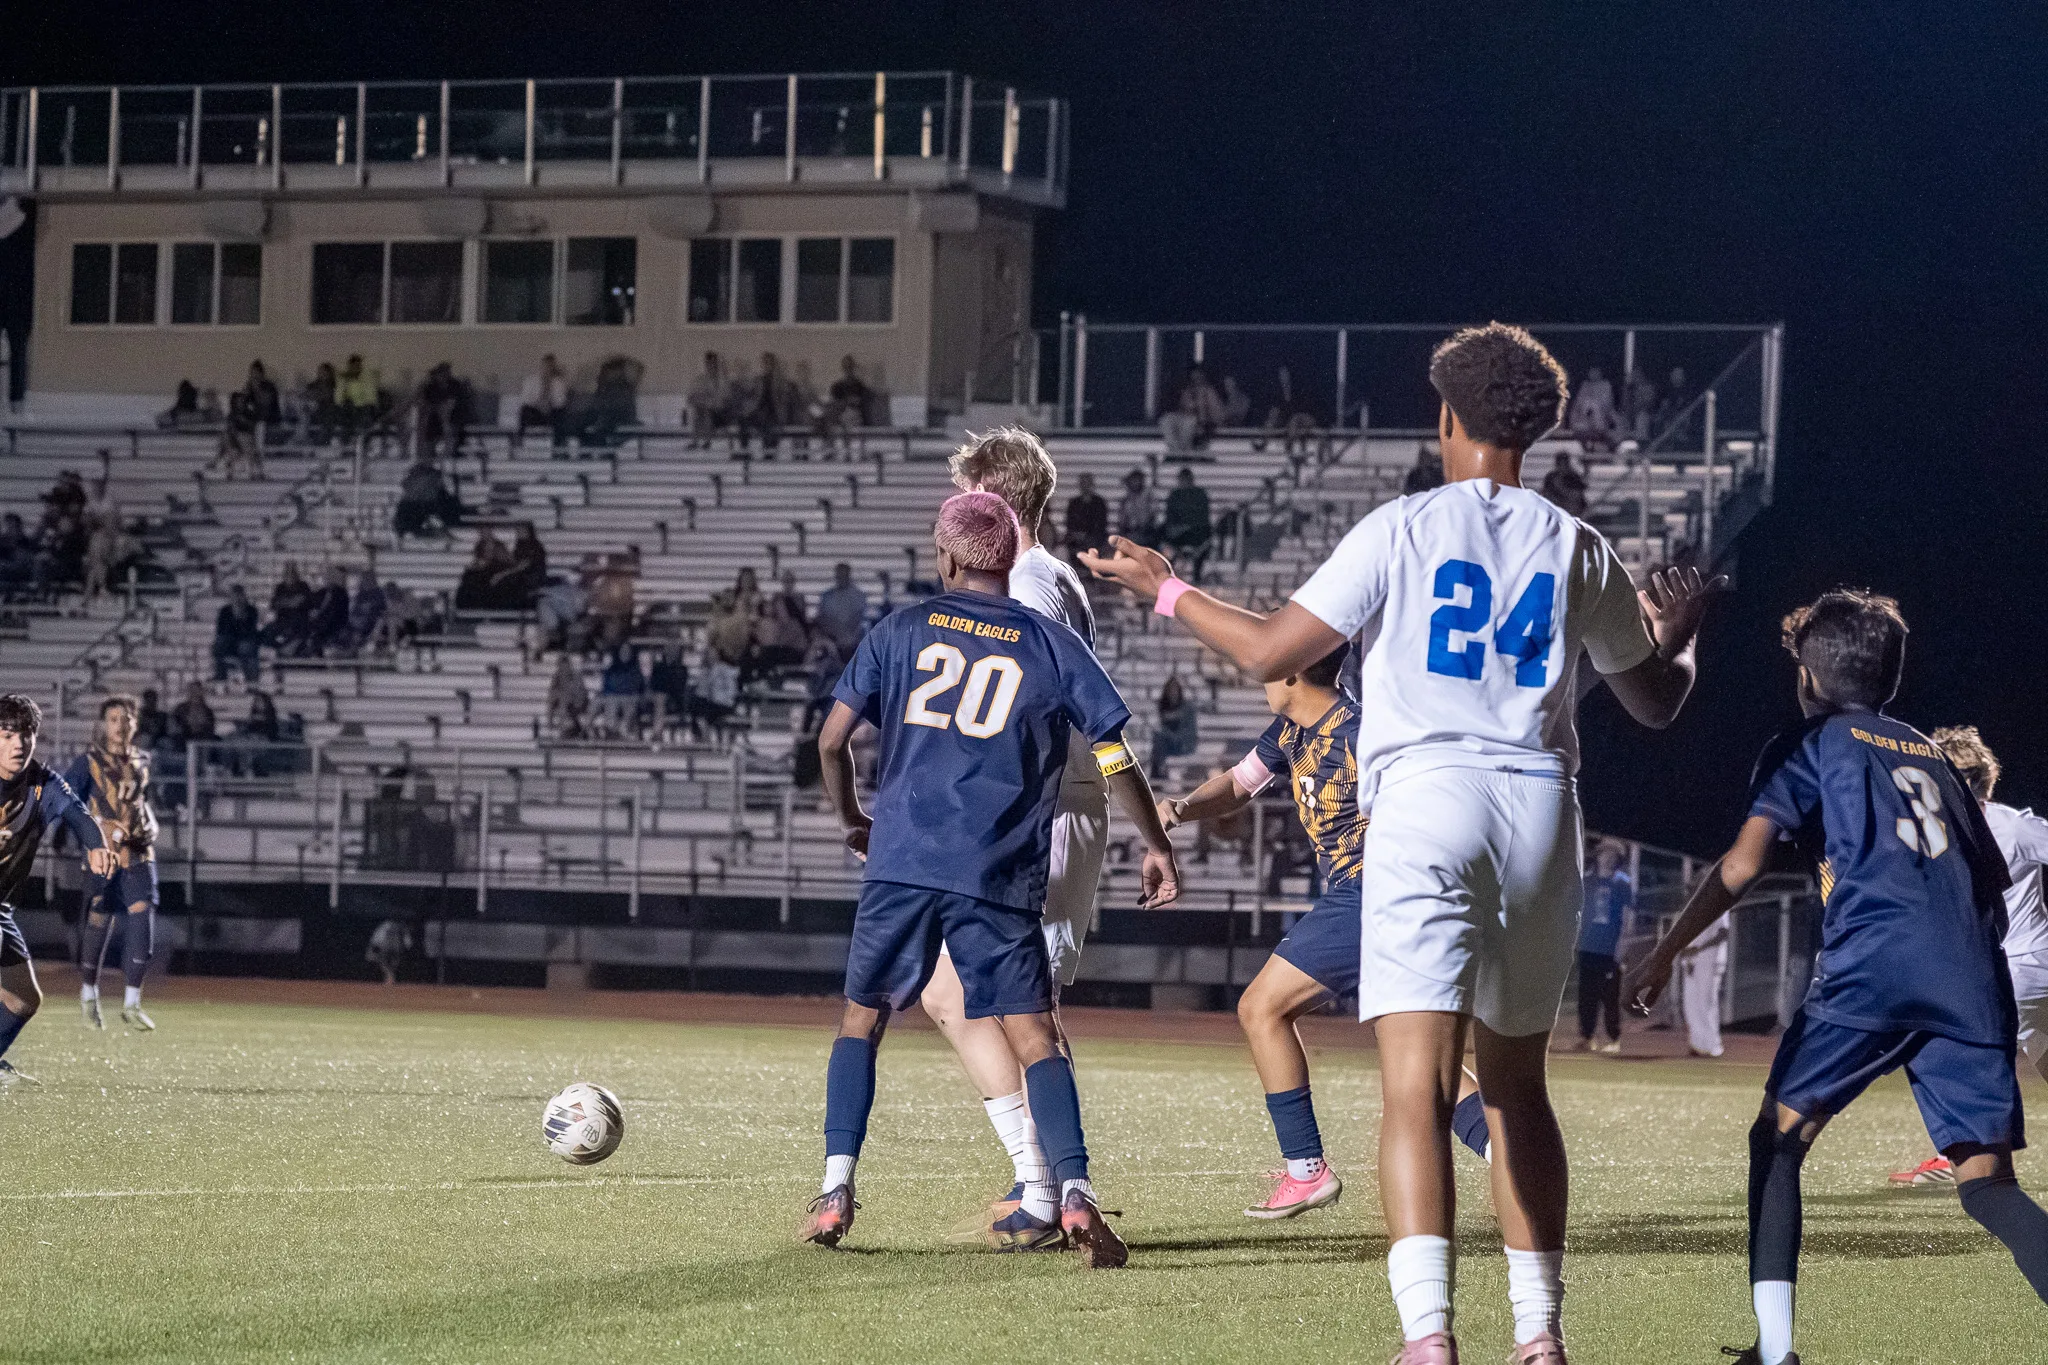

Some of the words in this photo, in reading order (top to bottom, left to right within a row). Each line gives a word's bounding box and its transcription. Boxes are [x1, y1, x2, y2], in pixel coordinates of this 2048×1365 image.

[928, 612, 975, 634] GOLDEN
[976, 623, 1021, 643] EAGLES
[1427, 559, 1555, 688] 24
[904, 642, 1024, 739] 20
[1851, 727, 1899, 753] GOLDEN
[1892, 766, 1948, 860] 3
